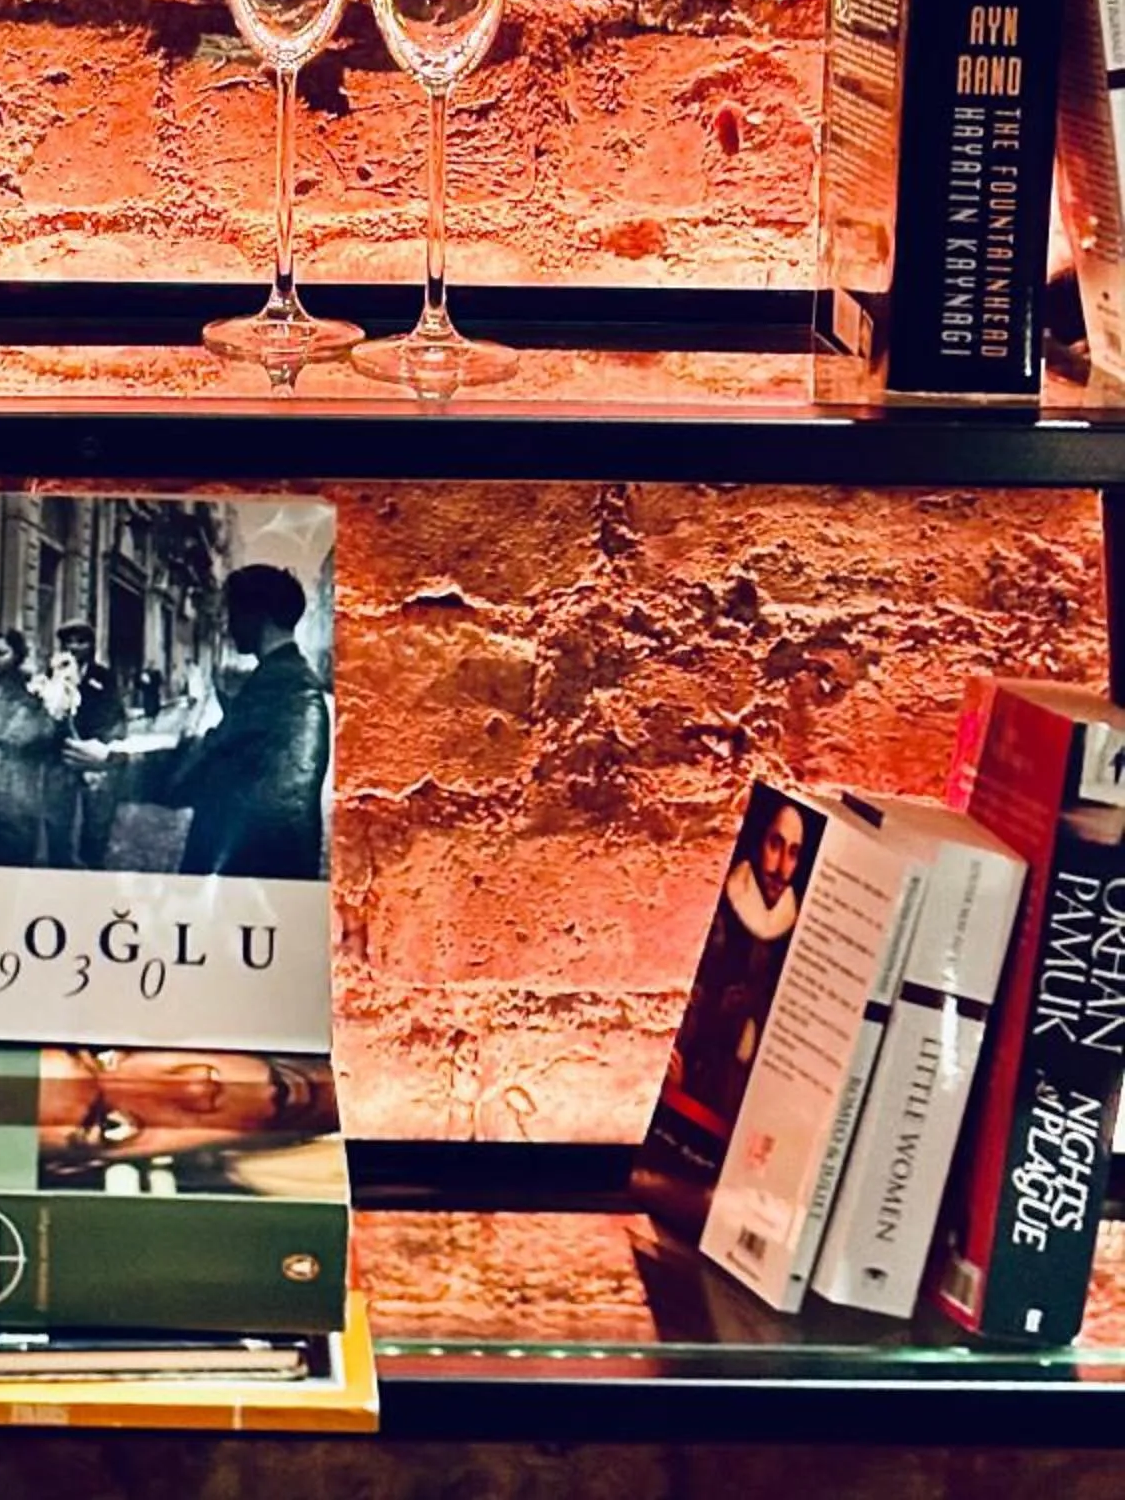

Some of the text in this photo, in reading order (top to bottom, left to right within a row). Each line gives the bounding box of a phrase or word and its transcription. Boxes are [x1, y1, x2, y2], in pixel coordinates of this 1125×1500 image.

[956, 55, 1023, 97] RAND
[969, 5, 1019, 46] AYN
[946, 106, 986, 223] HAYATIN
[980, 108, 1022, 358] THE FOUNTAINHEAD
[1033, 872, 1100, 1043] PAMUK
[1079, 876, 1125, 1054] ORHAN
[875, 1035, 944, 1244] LITTLE WOMEN
[1011, 1106, 1064, 1253] PLAGUE
[1049, 1090, 1102, 1232] NIGHTS
